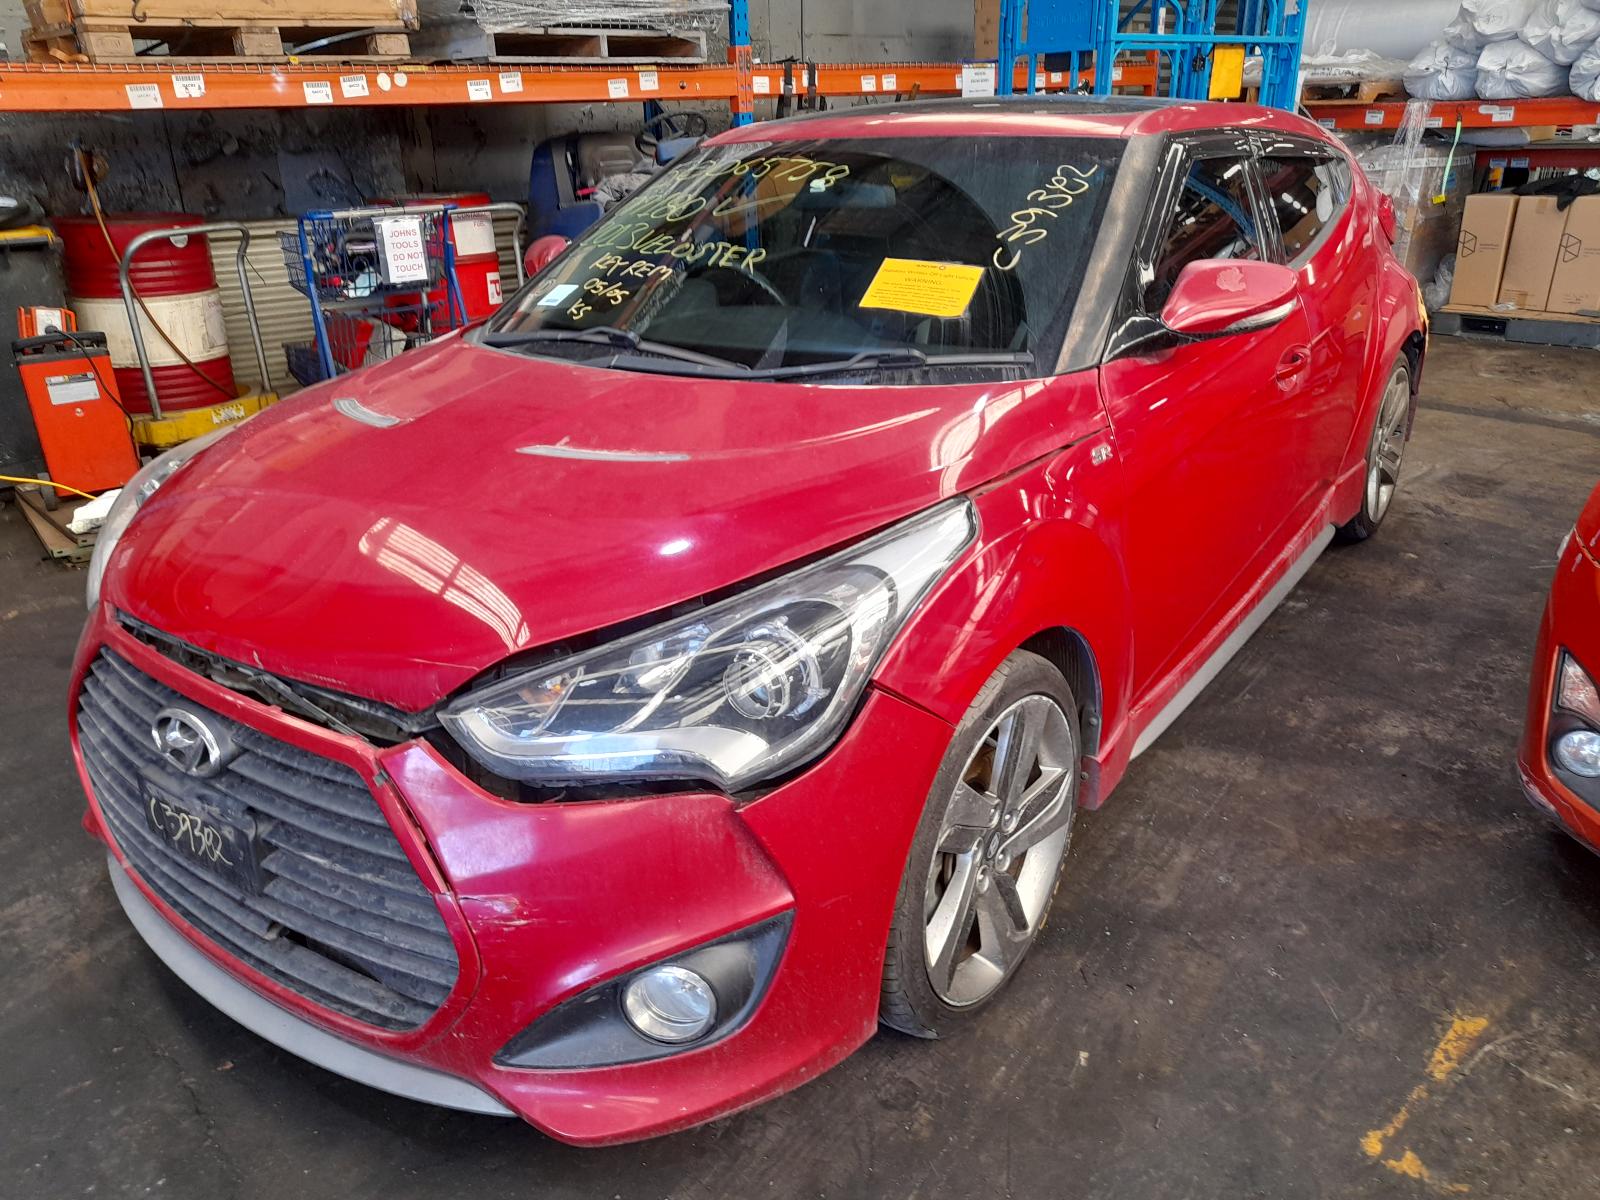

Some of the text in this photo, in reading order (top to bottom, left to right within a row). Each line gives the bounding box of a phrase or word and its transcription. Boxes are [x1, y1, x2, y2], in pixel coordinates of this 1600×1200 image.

[993, 164, 1098, 271] C39382
[389, 229, 417, 239] JOHNS
[391, 240, 419, 250] TOOLS
[393, 251, 425, 261] DO NOT
[633, 229, 767, 275] VELOSTER
[395, 263, 424, 273] TOUCH
